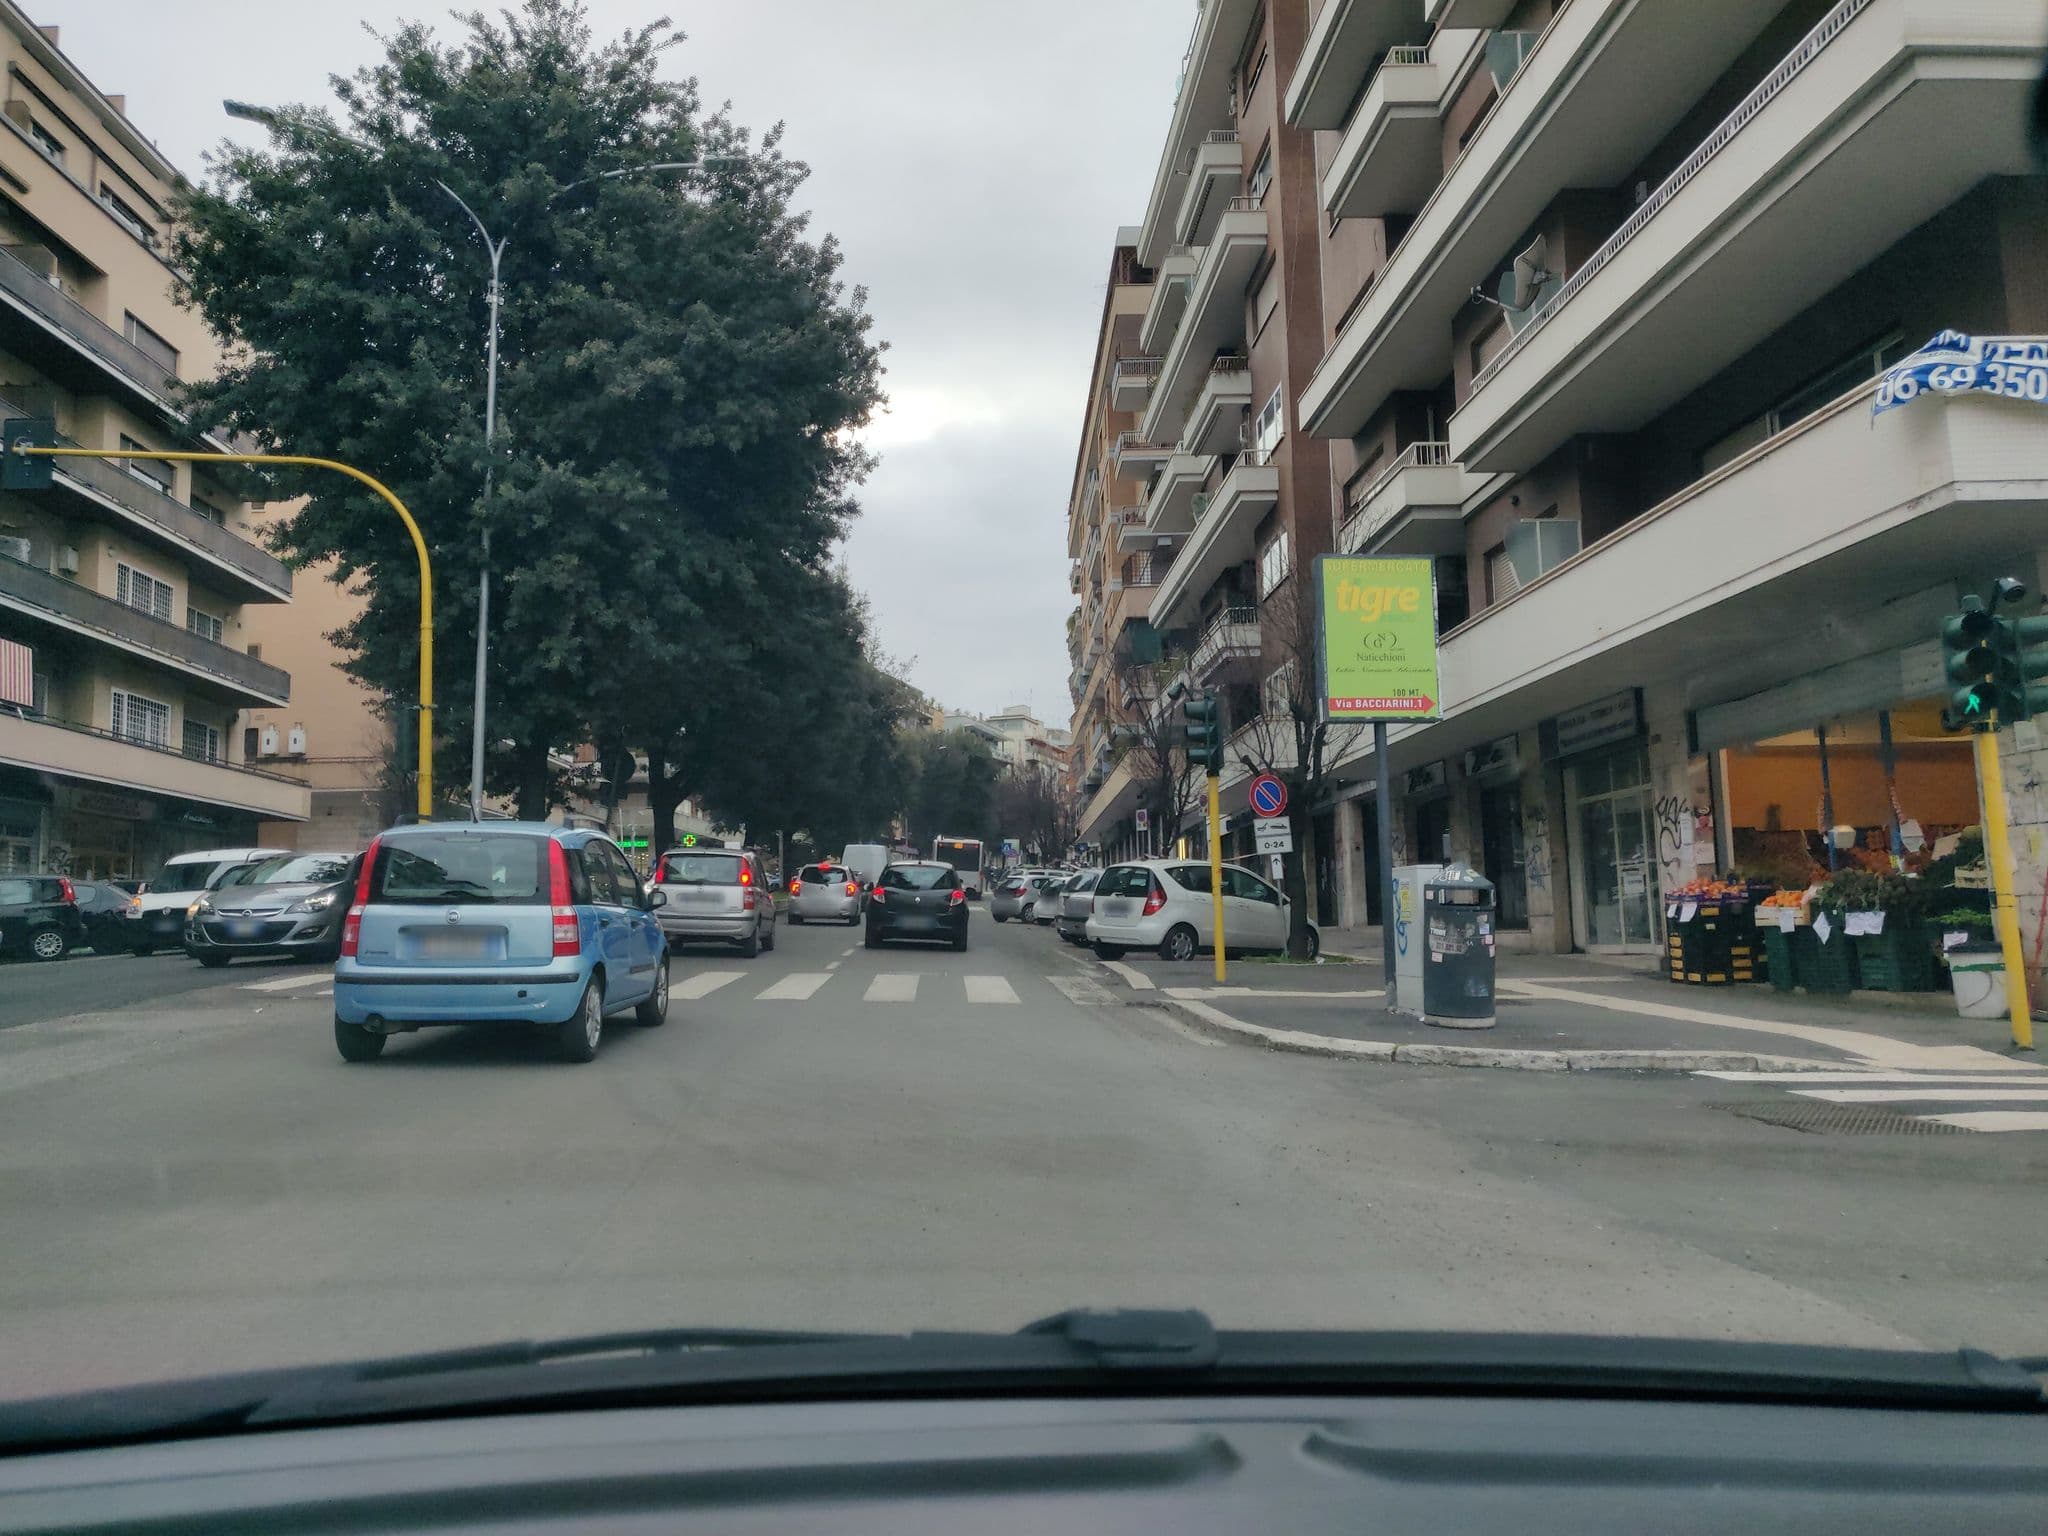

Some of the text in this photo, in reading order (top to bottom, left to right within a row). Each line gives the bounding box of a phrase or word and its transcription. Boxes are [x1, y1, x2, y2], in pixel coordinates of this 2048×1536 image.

[1336, 578, 1420, 623] tigre
[1393, 688, 1406, 697] 100
[1335, 699, 1352, 708] Via
[1264, 841, 1285, 849] 0-24
